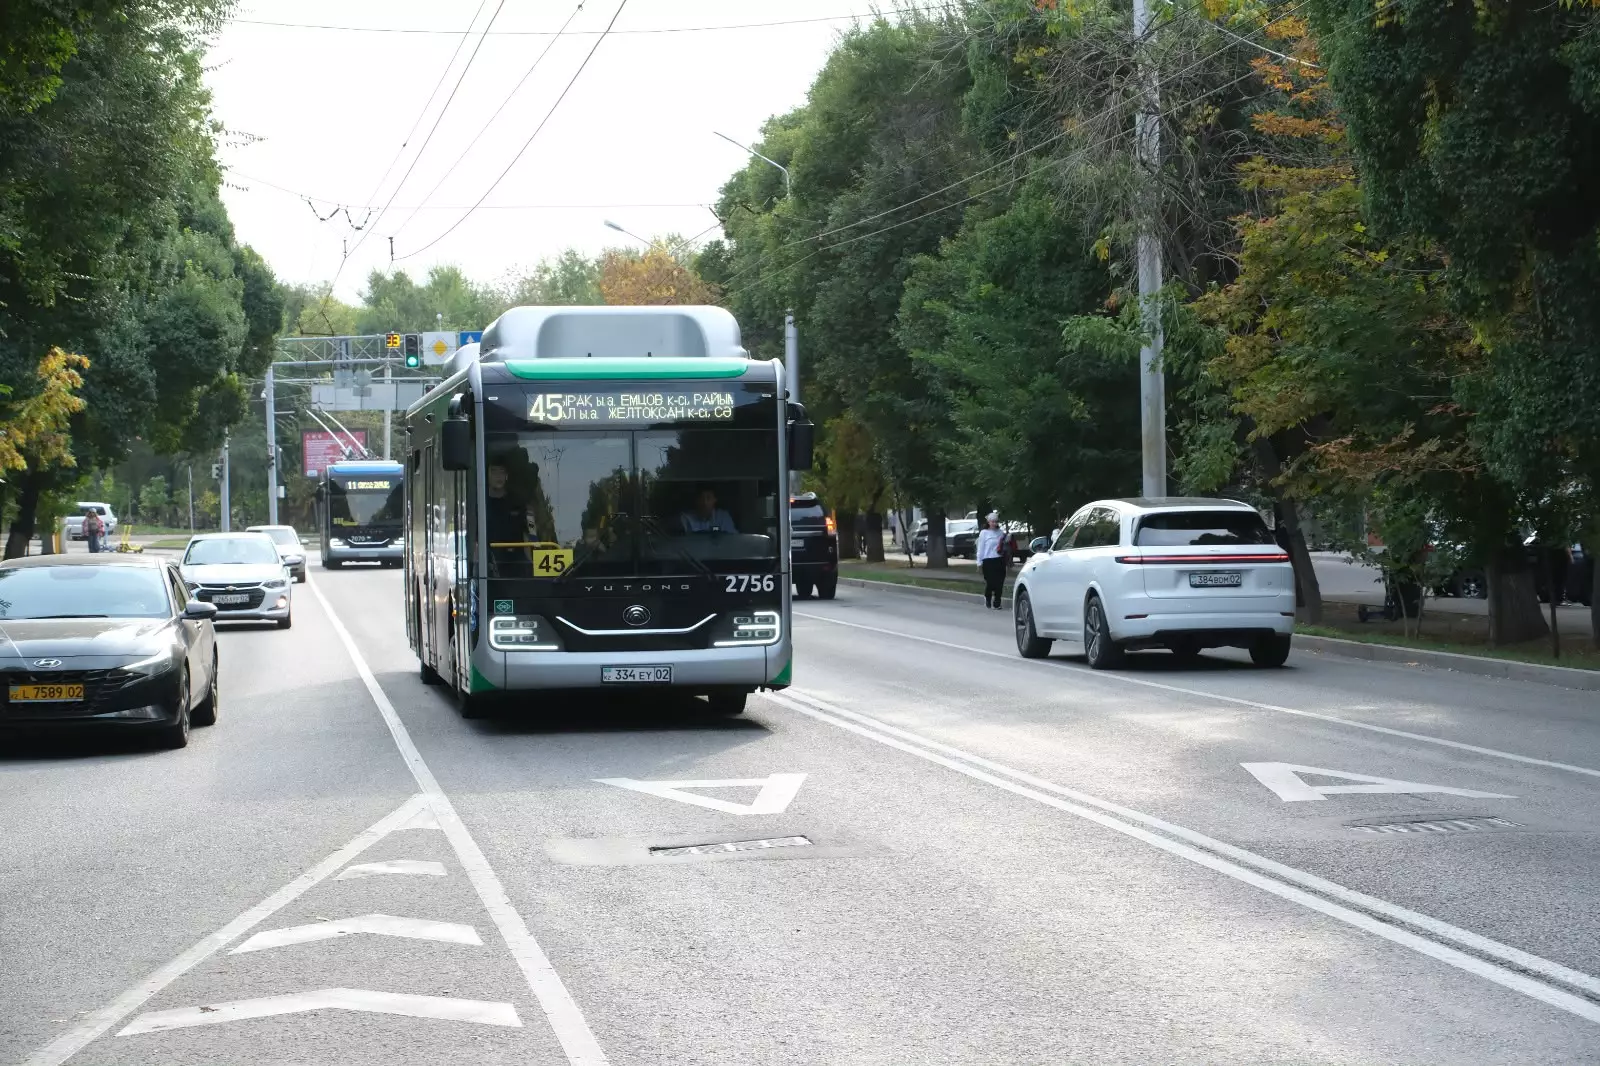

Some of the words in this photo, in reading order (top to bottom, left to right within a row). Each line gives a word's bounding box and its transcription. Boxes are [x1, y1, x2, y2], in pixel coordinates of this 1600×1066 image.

[386, 335, 400, 347] 33
[621, 394, 663, 406] ЕМЦОВ
[529, 394, 562, 420] 45
[608, 407, 684, 420] ЖЕЛТОҚСАН
[347, 481, 357, 489] 11
[538, 554, 566, 573] 45
[725, 575, 775, 593] 2756
[1230, 575, 1240, 584] 02
[585, 584, 690, 592] YUTONG
[615, 669, 636, 680] 334
[639, 671, 652, 680] EY
[655, 669, 669, 680] 02
[33, 686, 63, 699] 7589
[67, 686, 83, 698] 02
